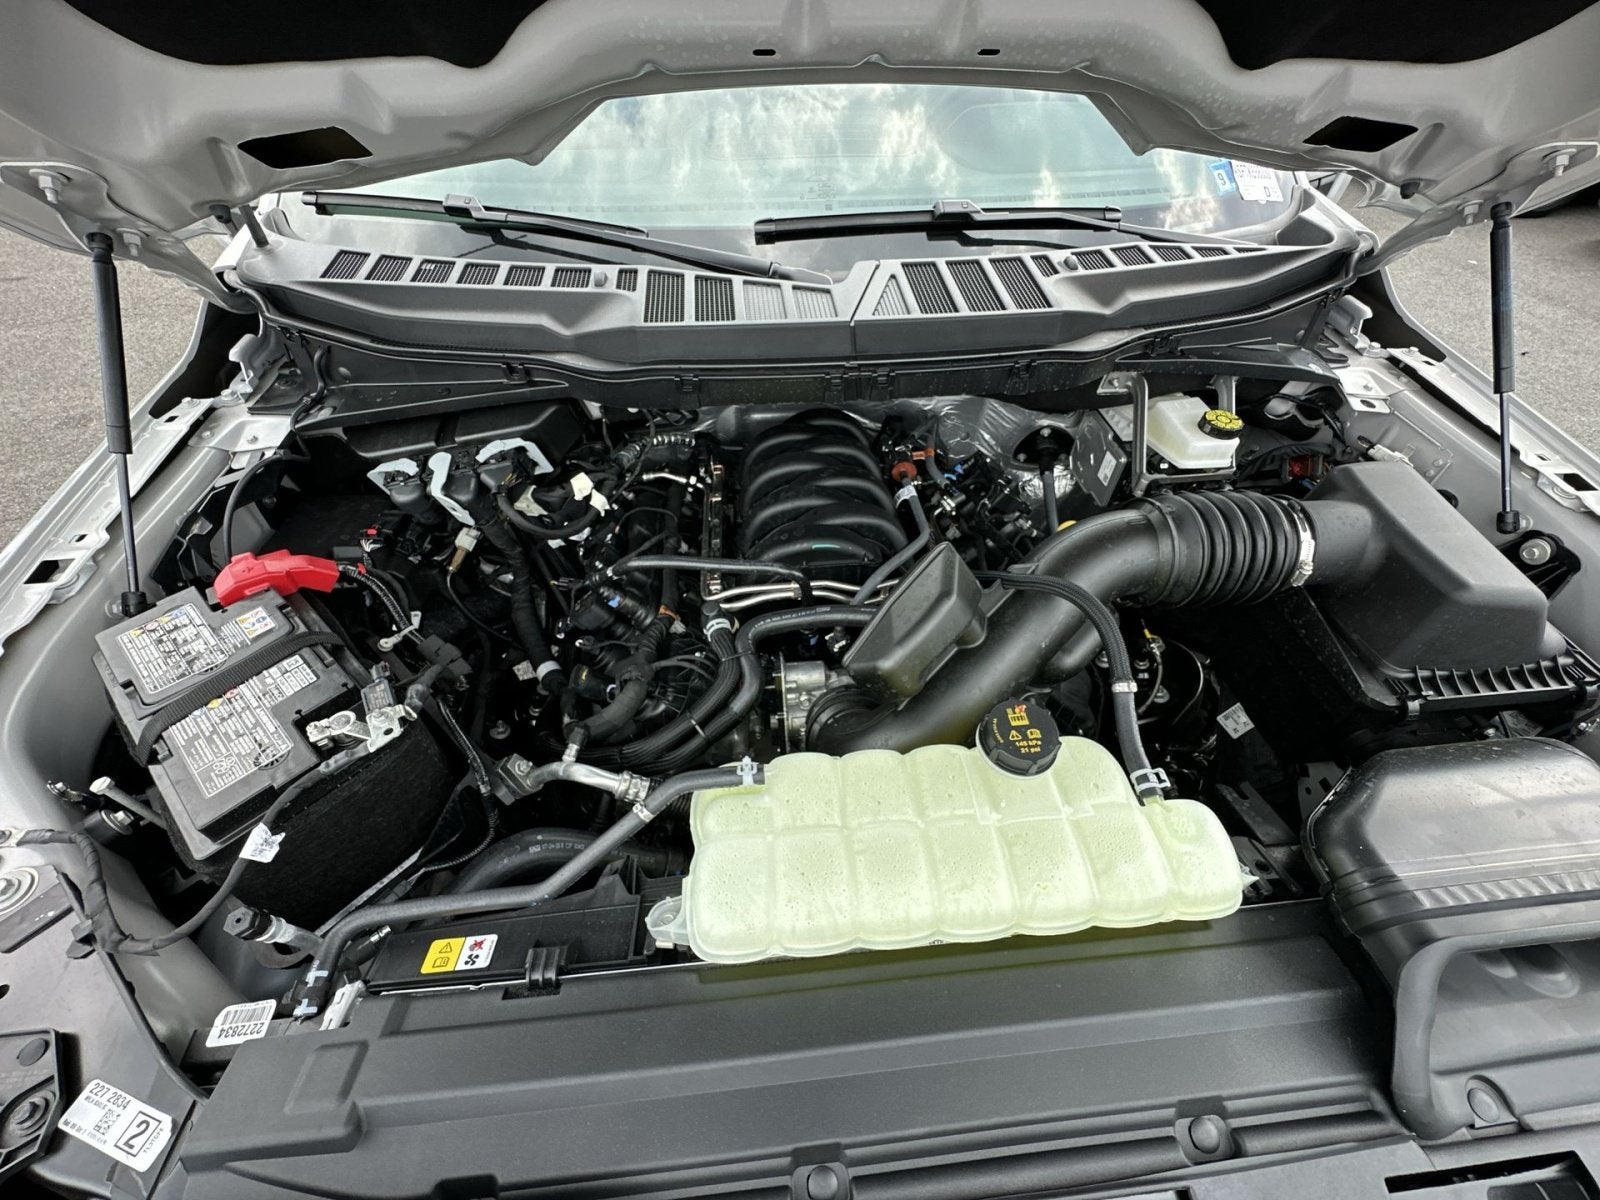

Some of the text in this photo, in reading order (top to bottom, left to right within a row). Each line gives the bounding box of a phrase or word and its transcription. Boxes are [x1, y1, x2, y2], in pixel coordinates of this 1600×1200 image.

[217, 1022, 265, 1039] 2272834
[89, 1082, 111, 1098] 227
[107, 1091, 132, 1111] 2834
[123, 1119, 150, 1150] 2
